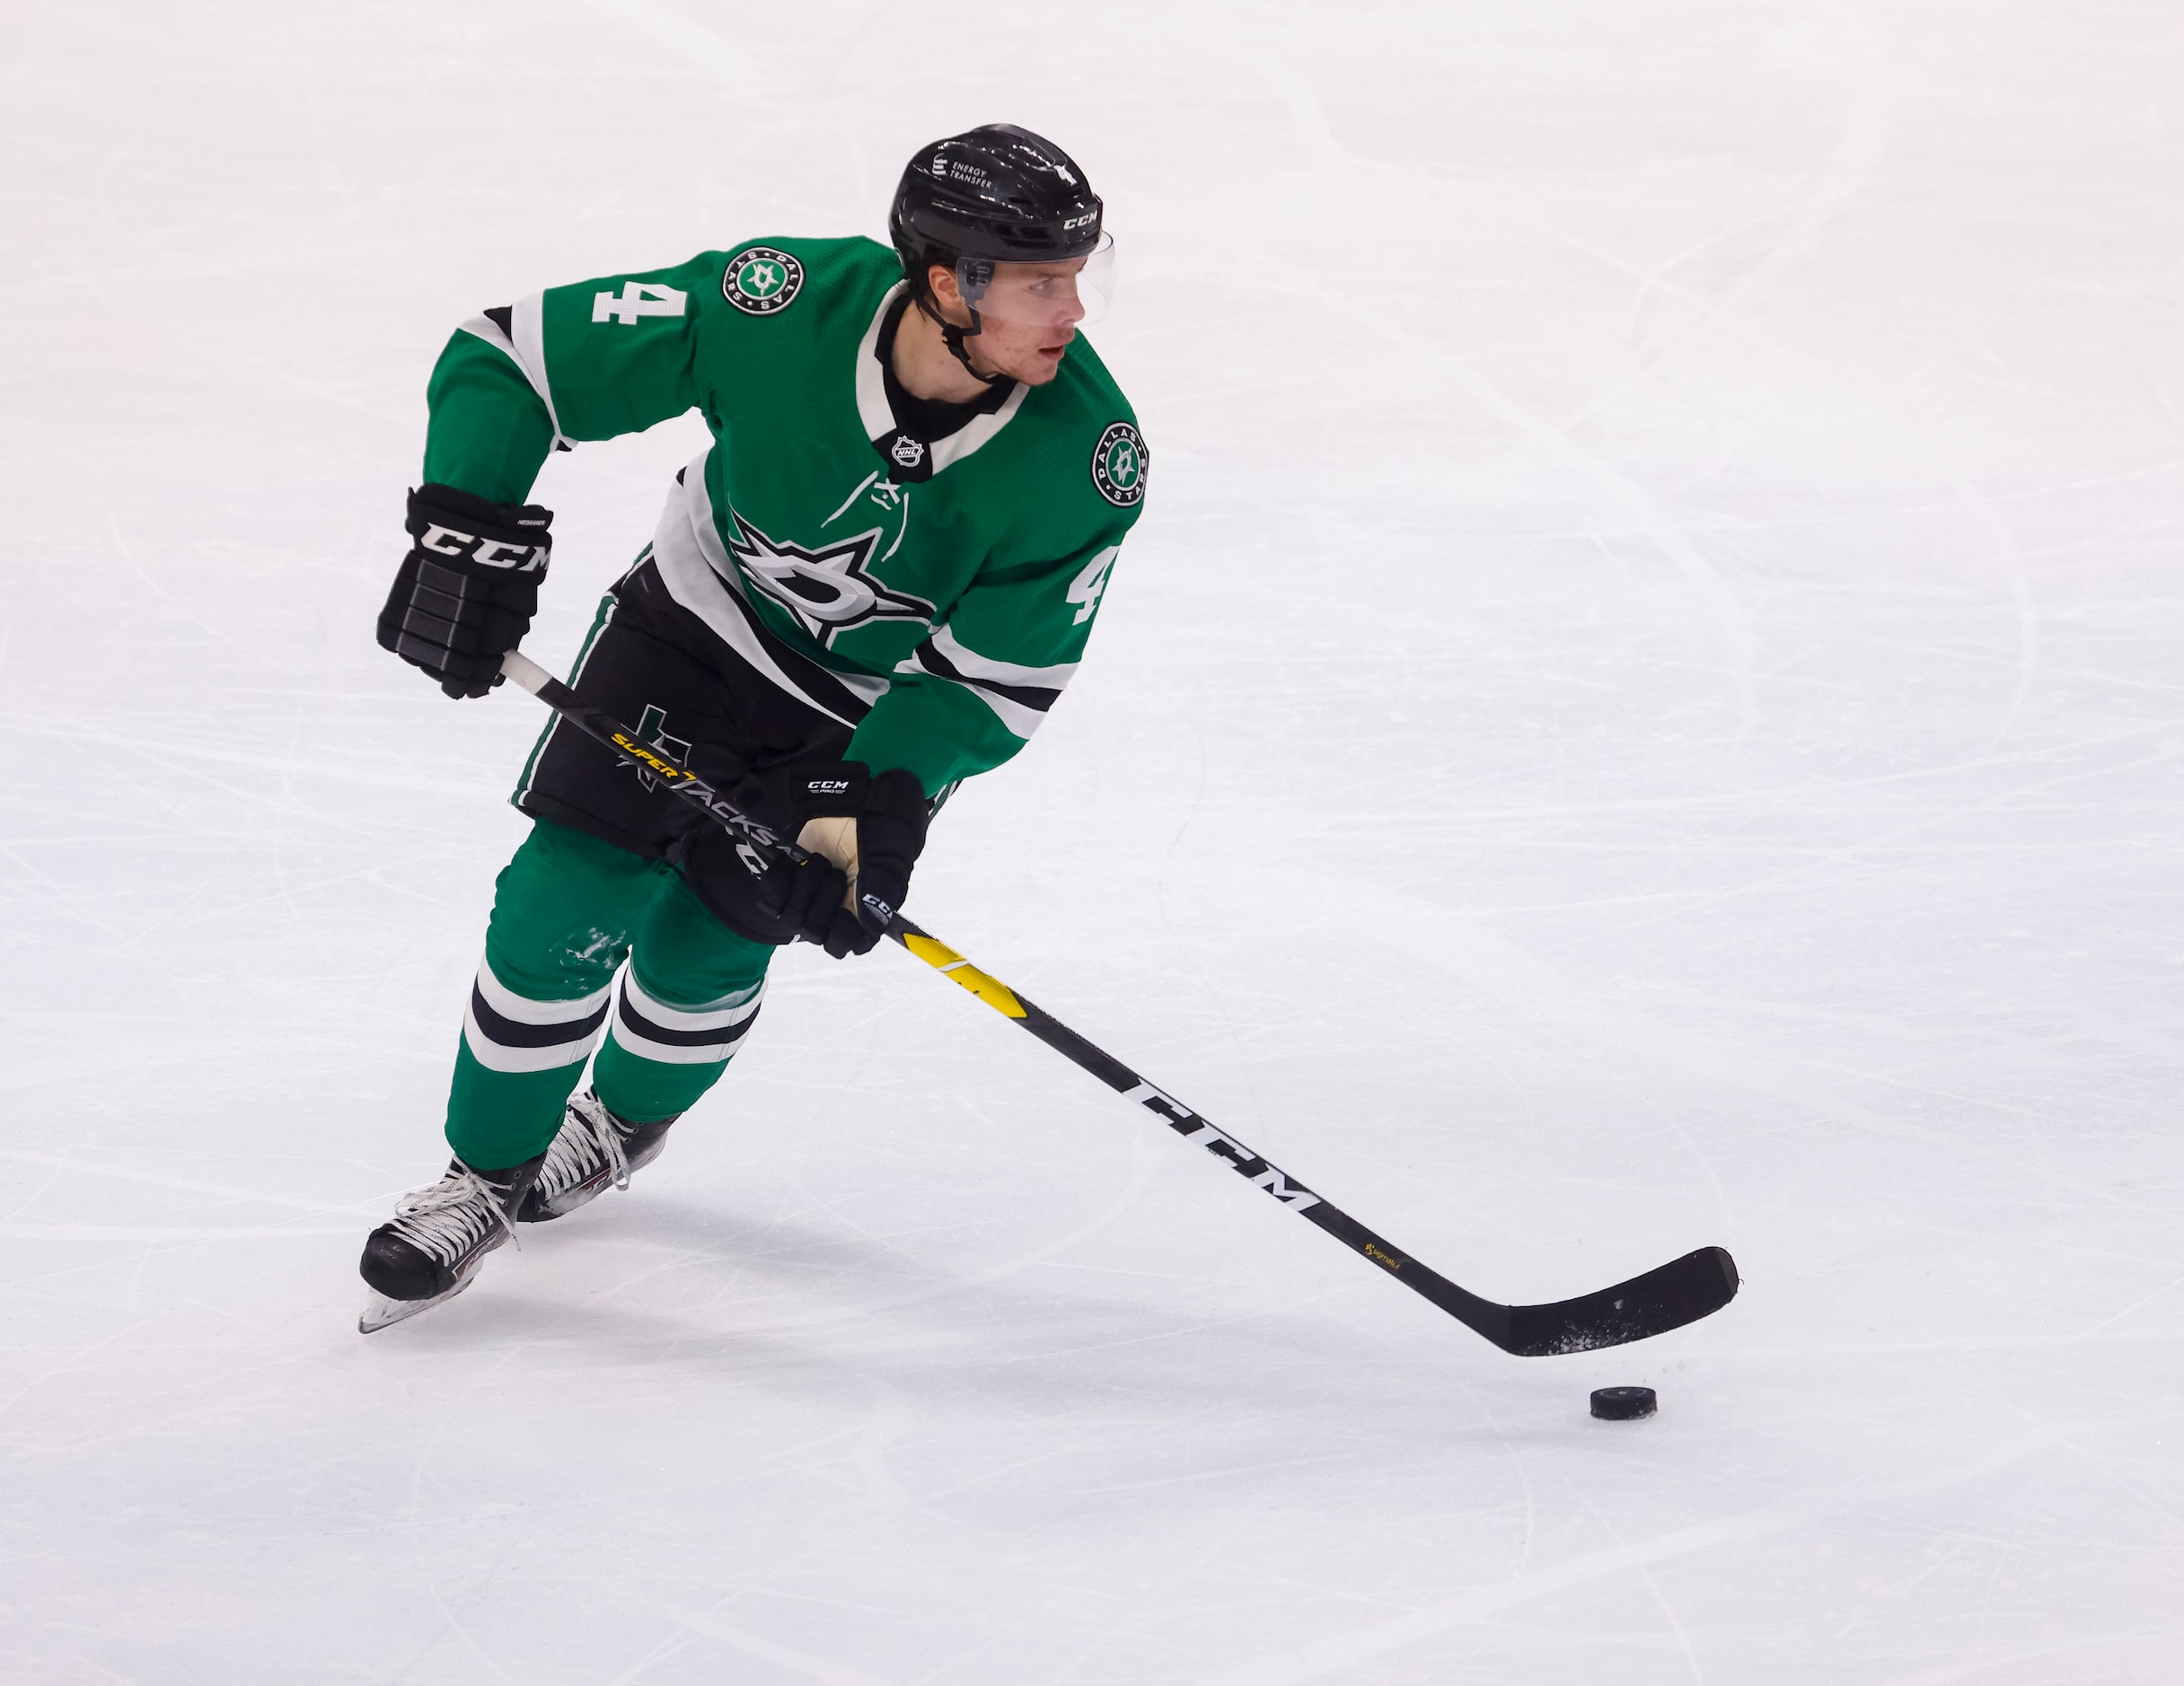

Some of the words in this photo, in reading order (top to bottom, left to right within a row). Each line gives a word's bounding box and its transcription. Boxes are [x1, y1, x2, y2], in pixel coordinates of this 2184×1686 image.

[949, 169, 992, 189] TRANSFER
[952, 161, 987, 178] ENERGY
[1062, 209, 1098, 231] CCM
[727, 251, 757, 301] STARS
[761, 254, 798, 311] DALLAS
[591, 280, 688, 325] 4
[1097, 428, 1137, 480] DALLAS
[419, 522, 551, 572] CCM
[1065, 545, 1121, 627] 4
[611, 733, 679, 778] SUPER
[776, 846, 807, 865] AS
[807, 780, 850, 789] CCM
[1123, 1076, 1322, 1212] CCM
